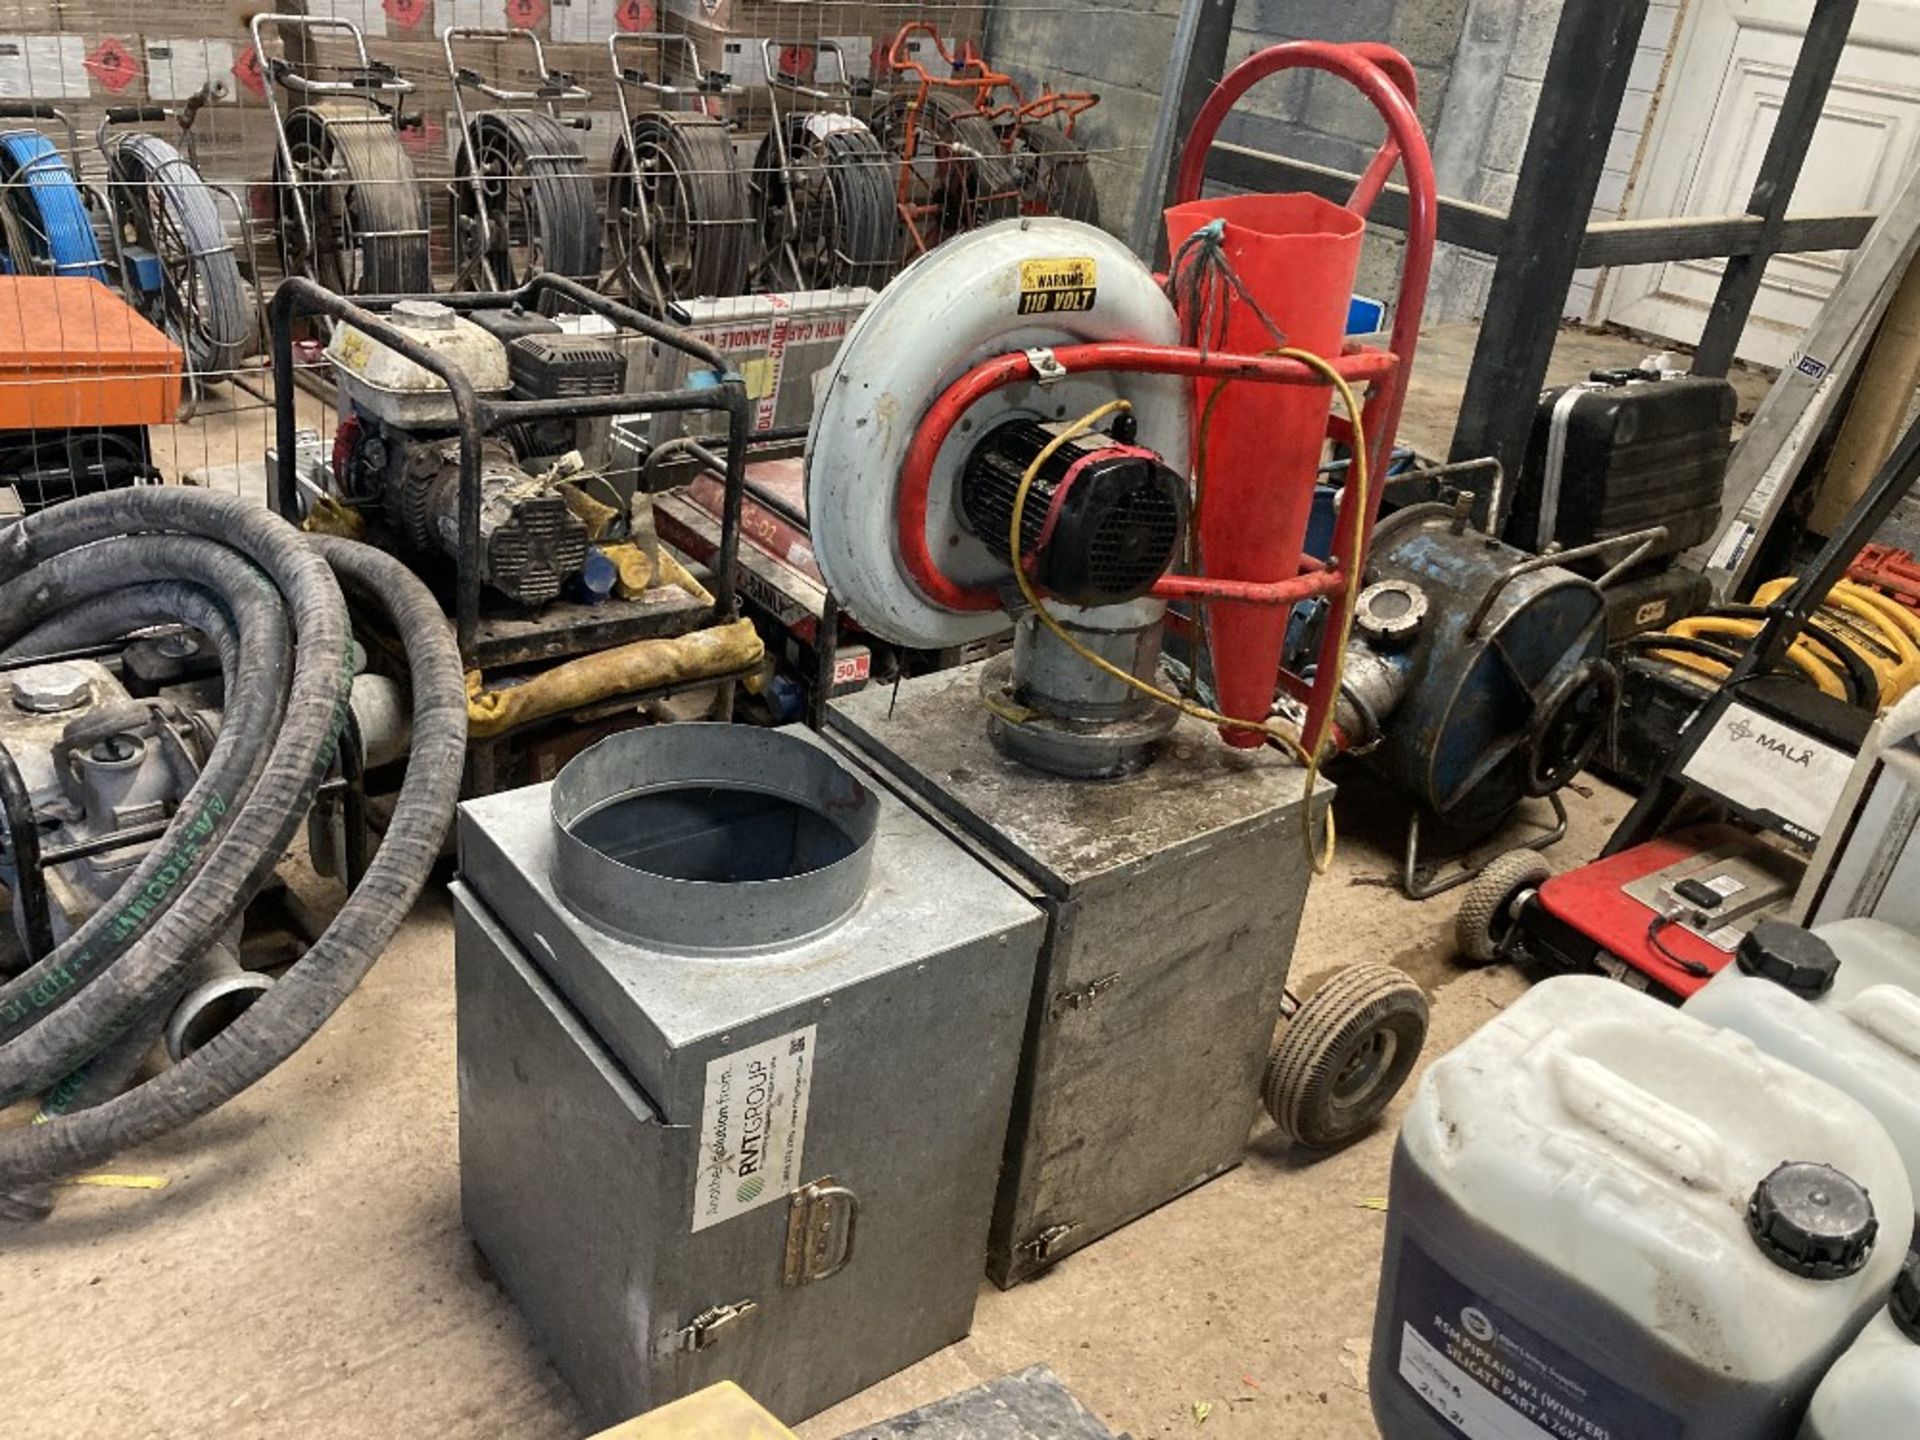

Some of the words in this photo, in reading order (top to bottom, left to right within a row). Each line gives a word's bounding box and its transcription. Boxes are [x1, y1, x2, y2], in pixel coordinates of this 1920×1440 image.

[1037, 271, 1084, 288] WARNING
[1023, 293, 1047, 313] 110
[1053, 290, 1092, 311] VOLT
[720, 326, 769, 349] HANDLE
[769, 320, 788, 358] CARE
[786, 324, 813, 342] CAR
[815, 319, 846, 338] WITH
[1756, 734, 1814, 767] MALÅ
[1782, 822, 1816, 842] EASY
[1434, 1314, 1461, 1343] RSM
[1462, 1337, 1516, 1382] PIPEAID
[1517, 1376, 1537, 1398] W1
[1541, 1392, 1609, 1440] (WINTER)
[1446, 1343, 1501, 1391] SILICATE
[1502, 1385, 1538, 1415] PART
[1539, 1412, 1549, 1426] A
